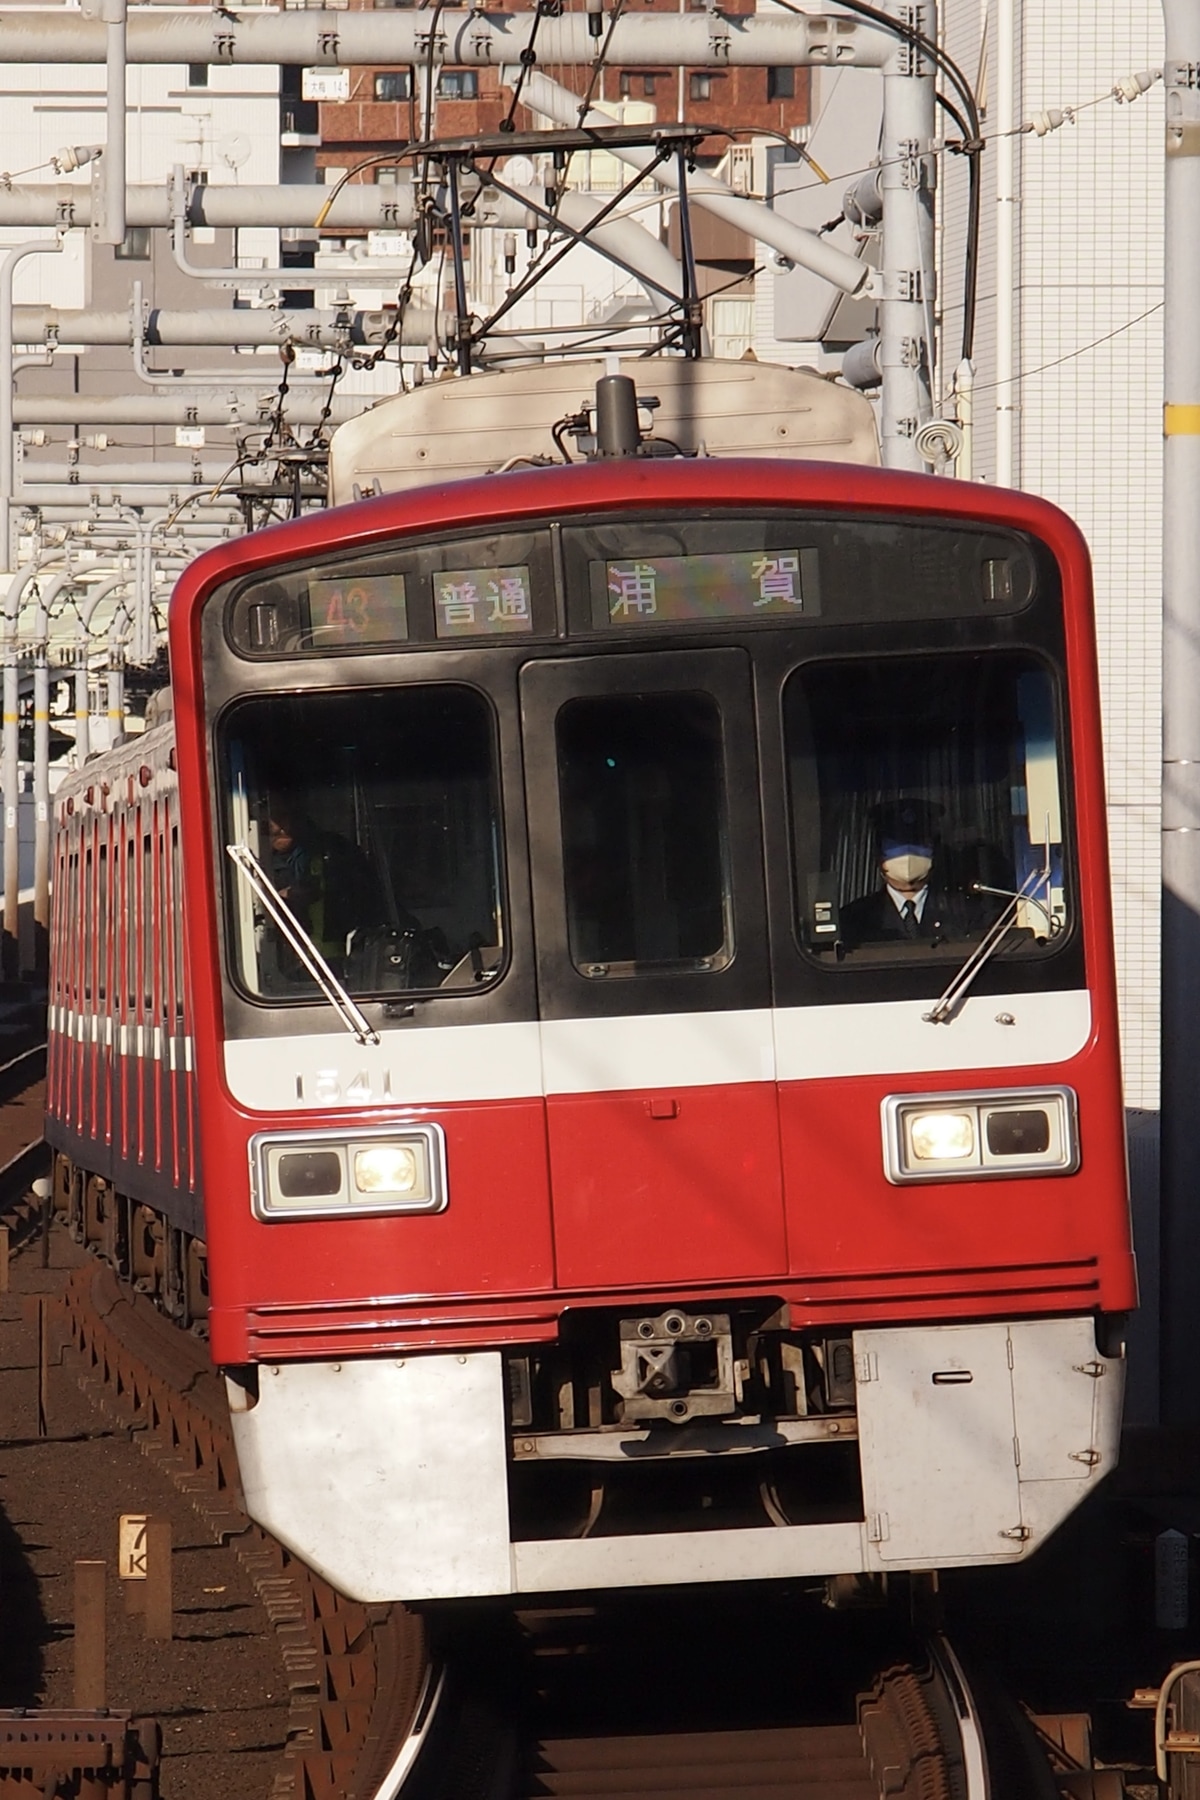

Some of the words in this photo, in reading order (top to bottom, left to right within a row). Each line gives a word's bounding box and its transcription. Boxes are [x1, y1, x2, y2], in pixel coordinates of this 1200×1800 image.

[438, 576, 529, 625] 普通
[608, 557, 803, 616] 浦賀
[326, 587, 370, 638] 43
[295, 1067, 392, 1104] 1541
[127, 1519, 147, 1549] 7
